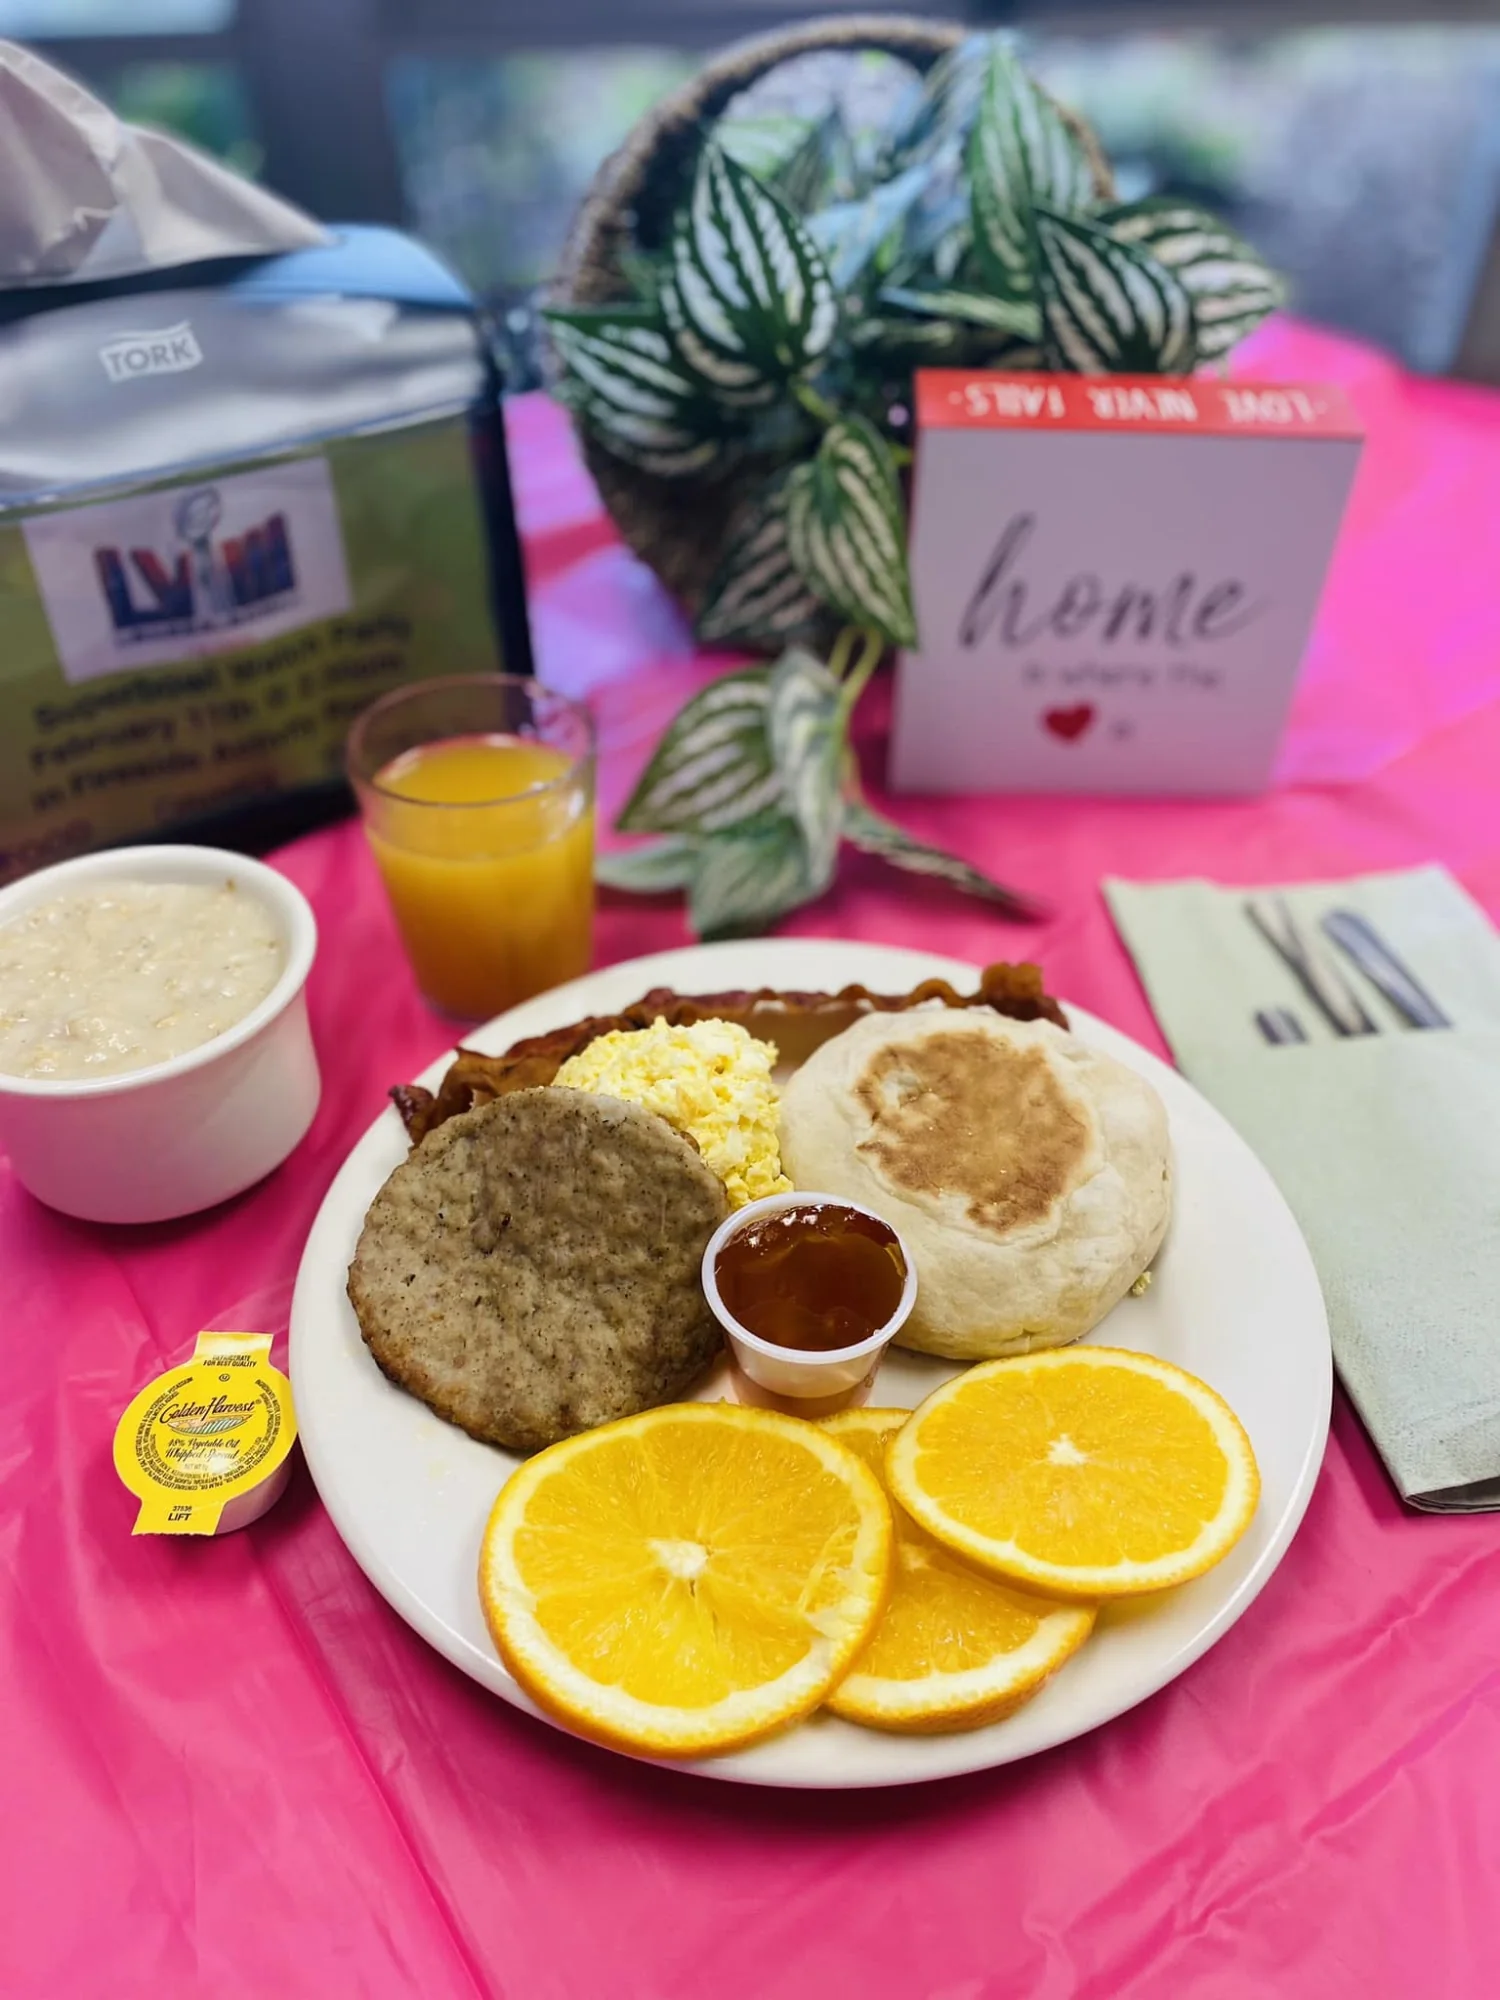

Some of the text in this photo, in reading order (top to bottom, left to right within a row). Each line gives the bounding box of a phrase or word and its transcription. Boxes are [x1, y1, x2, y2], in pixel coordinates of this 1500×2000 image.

[106, 337, 195, 376] TORK
[964, 381, 1066, 419] FAILS
[957, 510, 1264, 652] home
[232, 1360, 257, 1368] QUALITY
[160, 1395, 255, 1424] Golden Harvest
[188, 1438, 224, 1450] Vegetable
[225, 1439, 240, 1448] Oil
[165, 1448, 205, 1462] Whipped
[168, 1512, 192, 1521] LIFT
